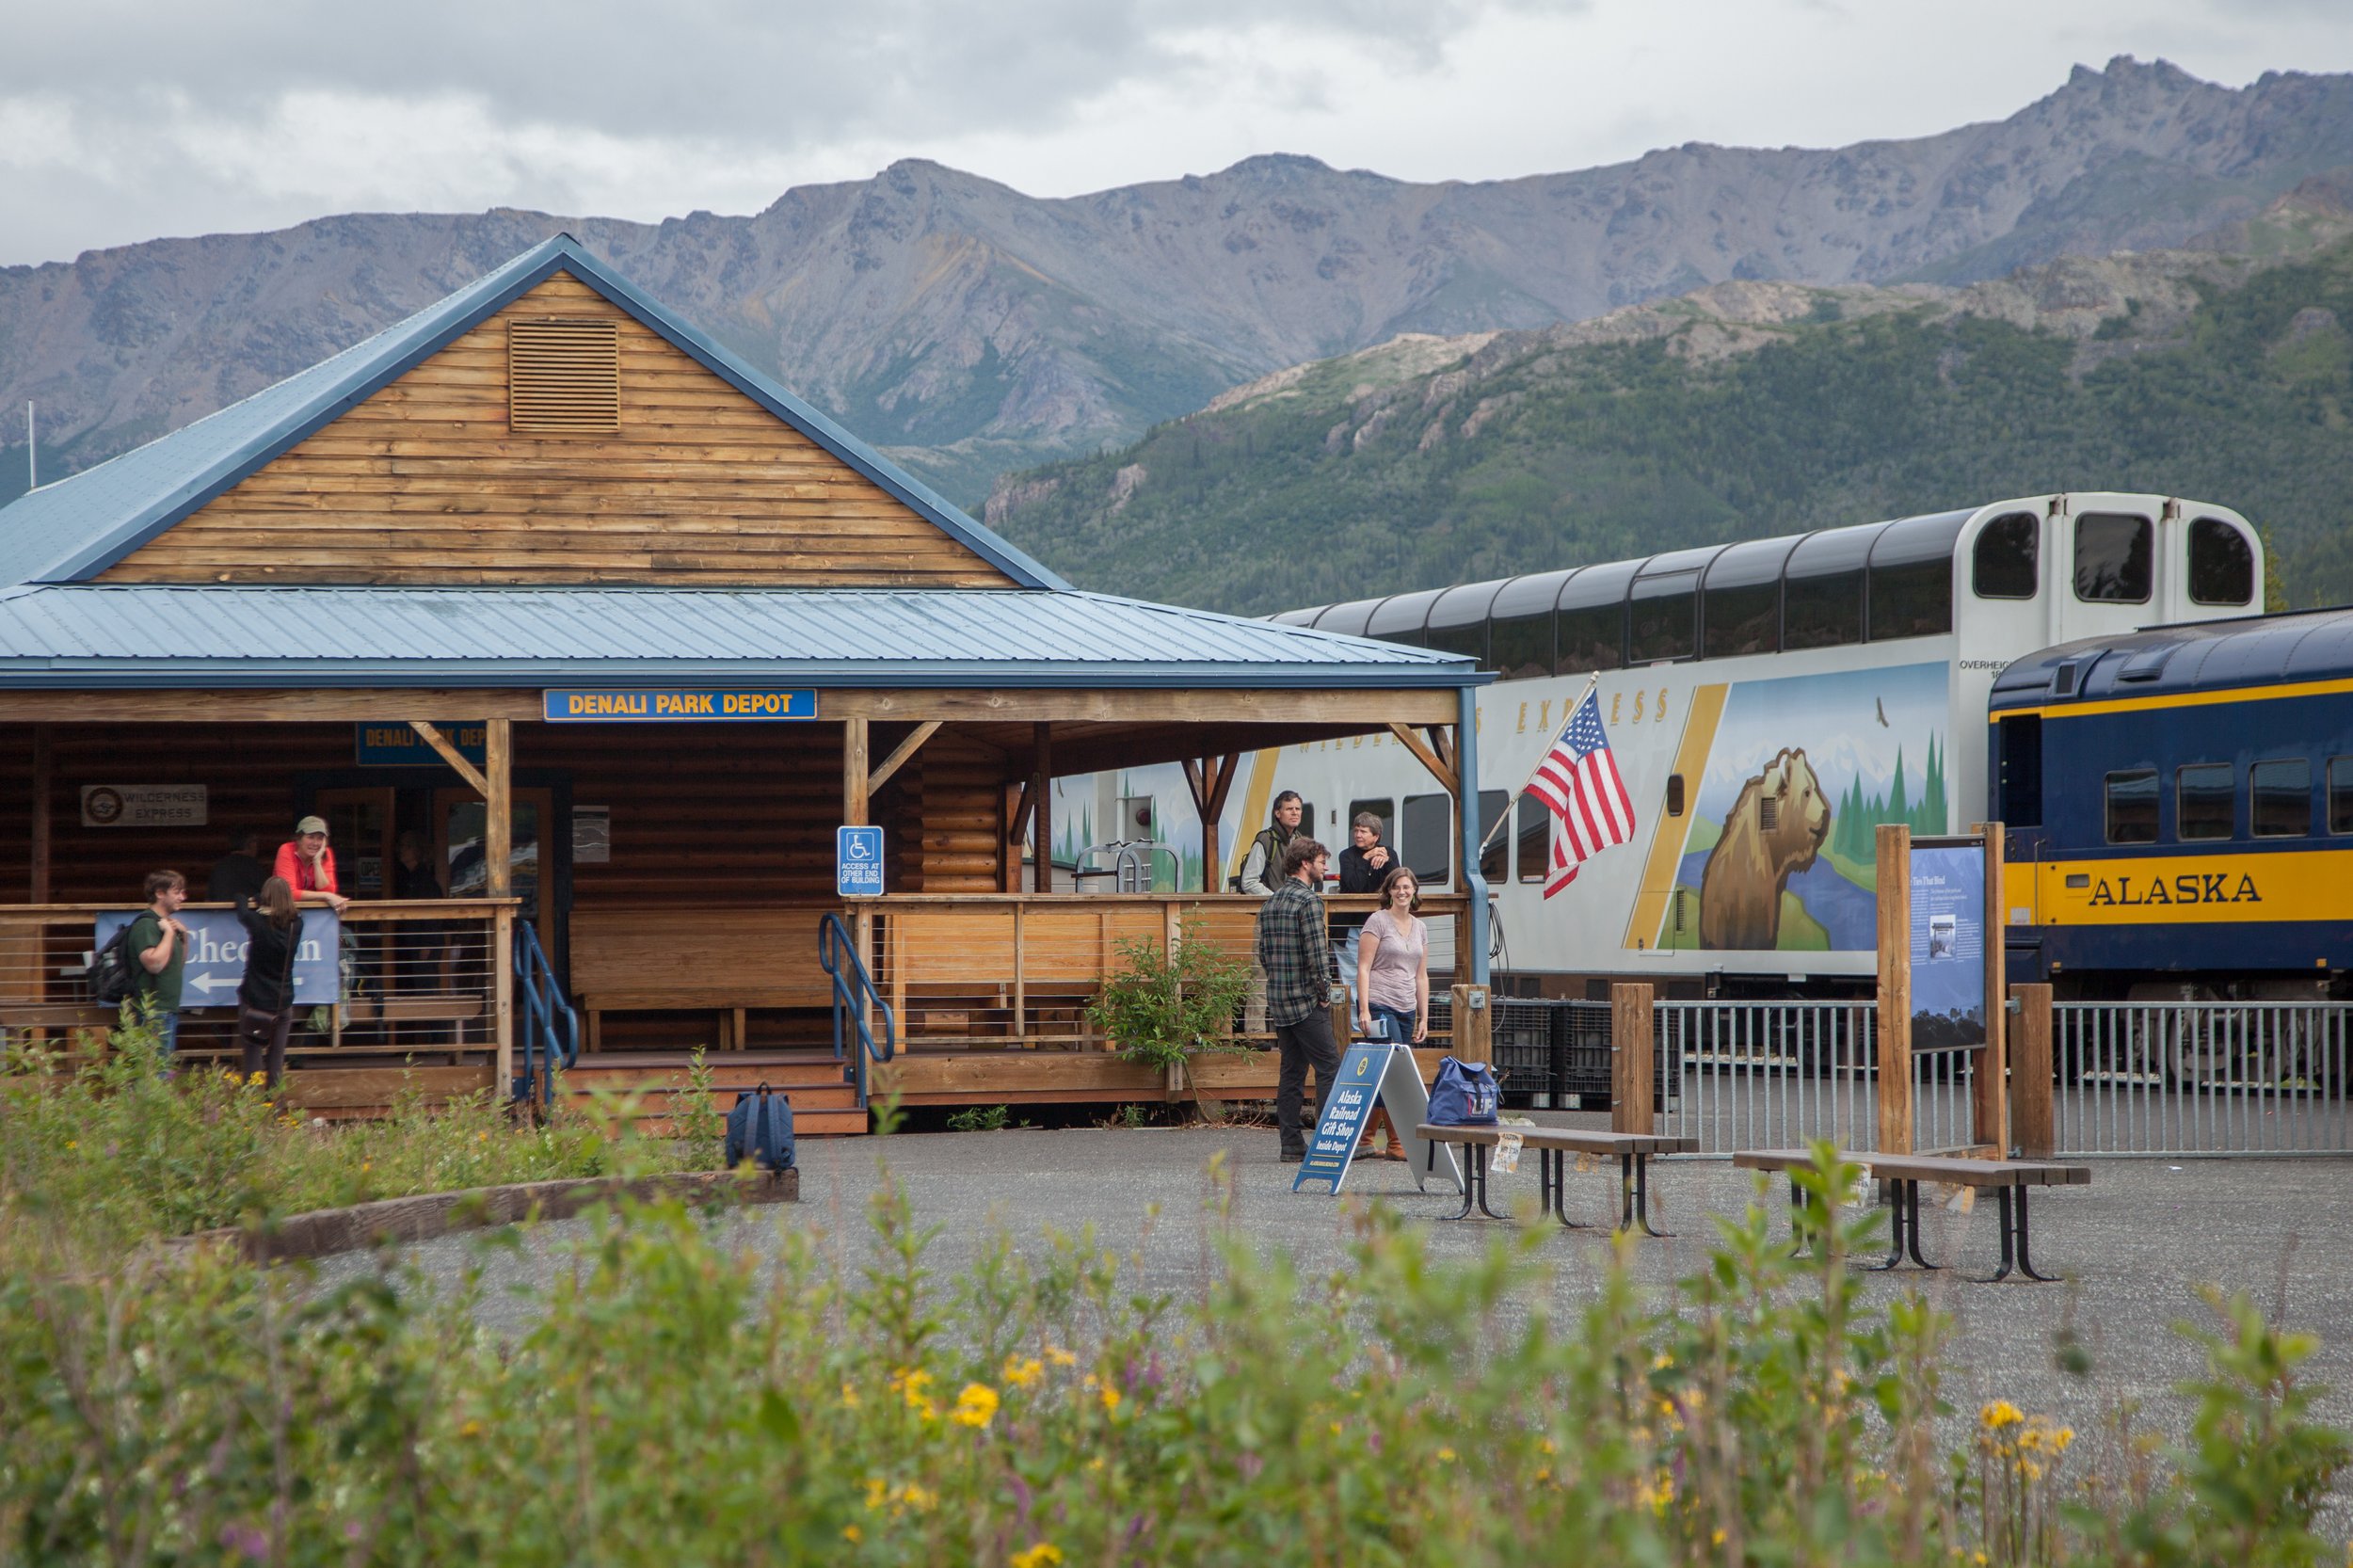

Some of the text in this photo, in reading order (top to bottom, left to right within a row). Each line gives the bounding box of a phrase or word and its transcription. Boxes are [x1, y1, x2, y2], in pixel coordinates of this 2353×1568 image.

[1960, 660, 2012, 669] OVERHEIG
[568, 694, 792, 714] DENALI PARK DEPOT
[1516, 687, 1669, 733] EXPESS
[365, 728, 414, 747] DENALI
[460, 728, 487, 747] DEP
[124, 792, 205, 803] WILDERNESS
[135, 808, 193, 819] EXPRESS
[2089, 872, 2262, 905] ALASKA
[1337, 1090, 1362, 1104] Alaska
[1329, 1106, 1361, 1120] Railroad
[1321, 1122, 1354, 1140] Gift Shop
[1316, 1140, 1347, 1154] Inside Depot
